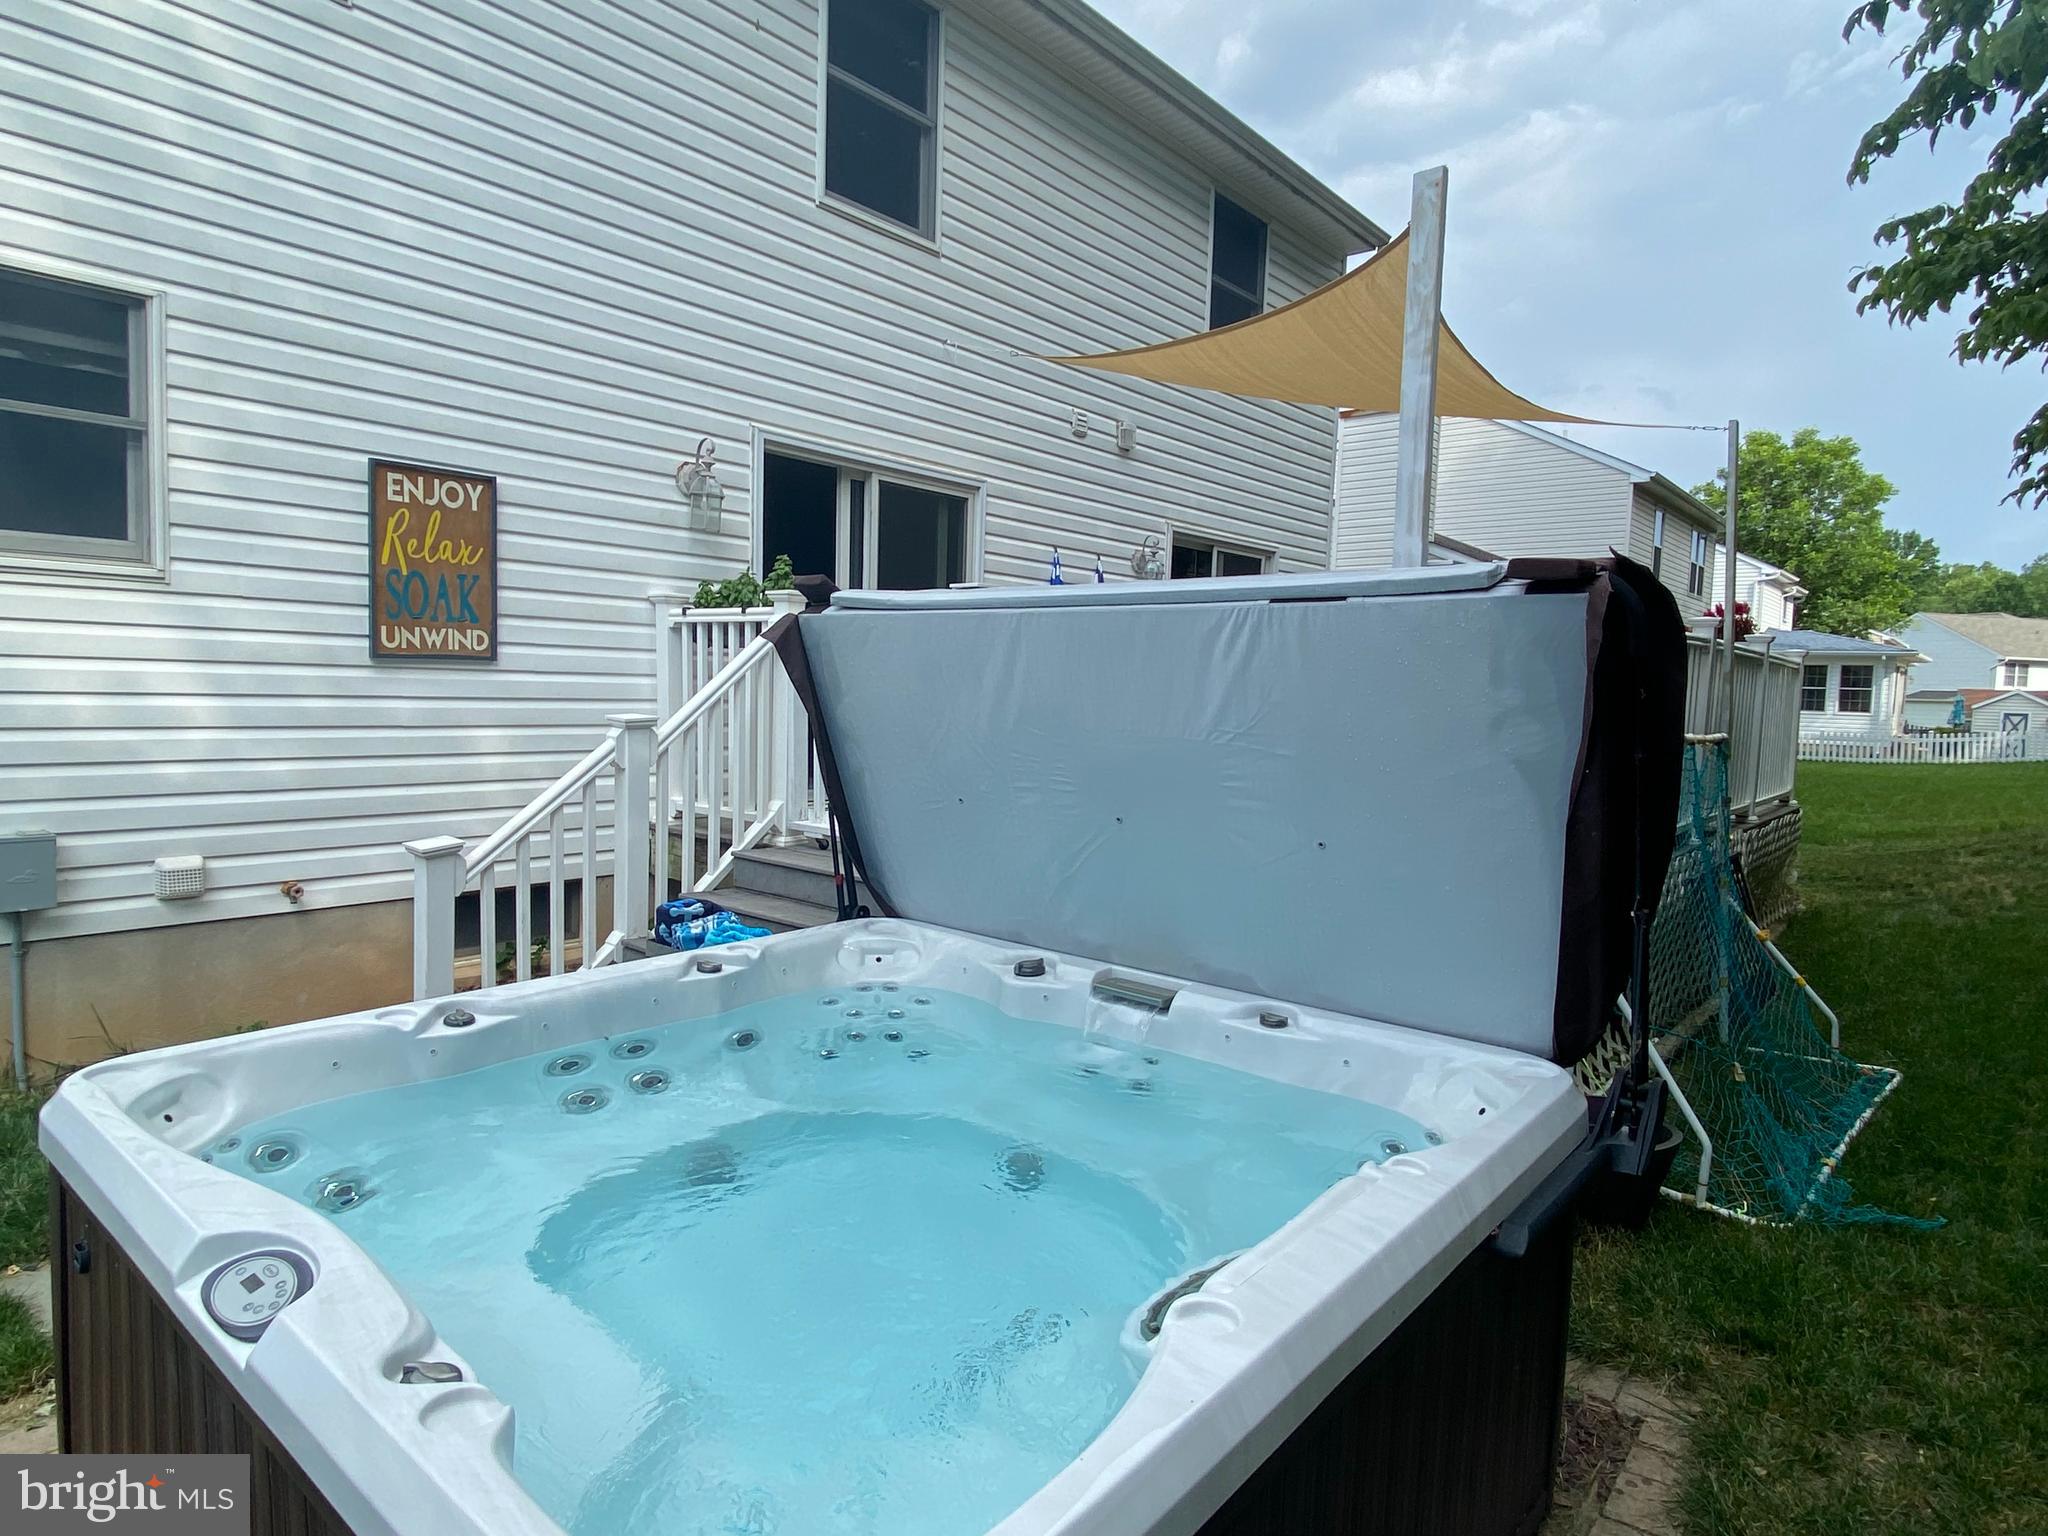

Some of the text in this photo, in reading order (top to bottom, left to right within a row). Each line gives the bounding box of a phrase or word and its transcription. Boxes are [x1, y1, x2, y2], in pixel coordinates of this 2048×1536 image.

[386, 472, 484, 511] ENJOY
[381, 508, 484, 575] Relax
[384, 568, 480, 624] SOAK
[380, 625, 489, 651] UNWIND
